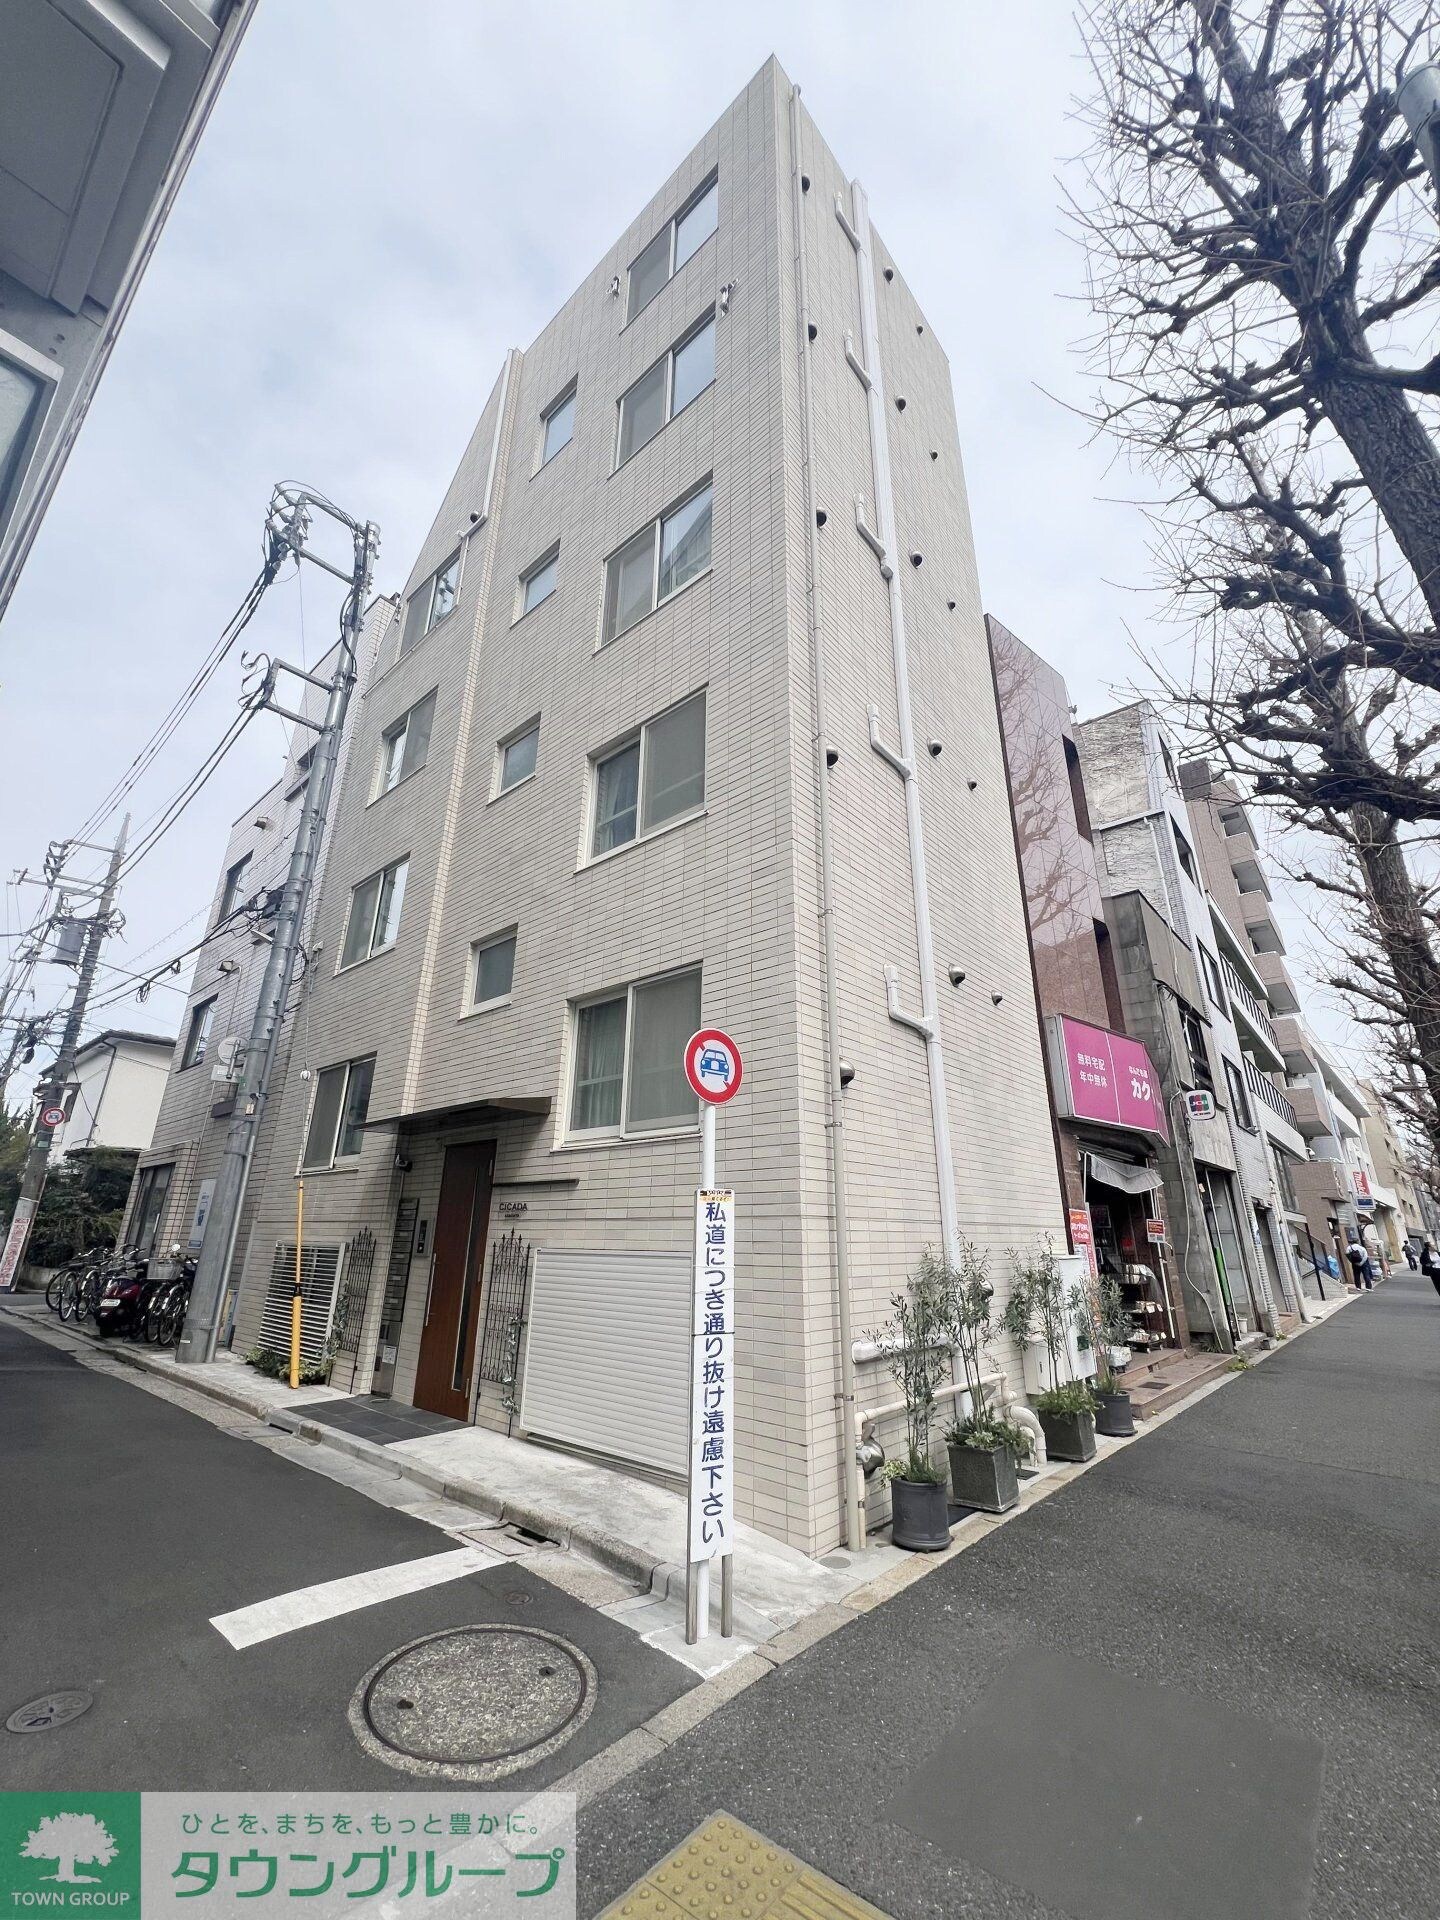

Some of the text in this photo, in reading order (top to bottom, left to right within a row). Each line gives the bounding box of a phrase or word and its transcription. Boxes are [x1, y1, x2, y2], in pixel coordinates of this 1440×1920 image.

[1077, 1052, 1106, 1071] 無料宅配
[1079, 1070, 1108, 1088] 年中無休
[499, 1202, 528, 1212] CICADA
[701, 1202, 726, 1543] 私道につき通り抜け遠慮下さい
